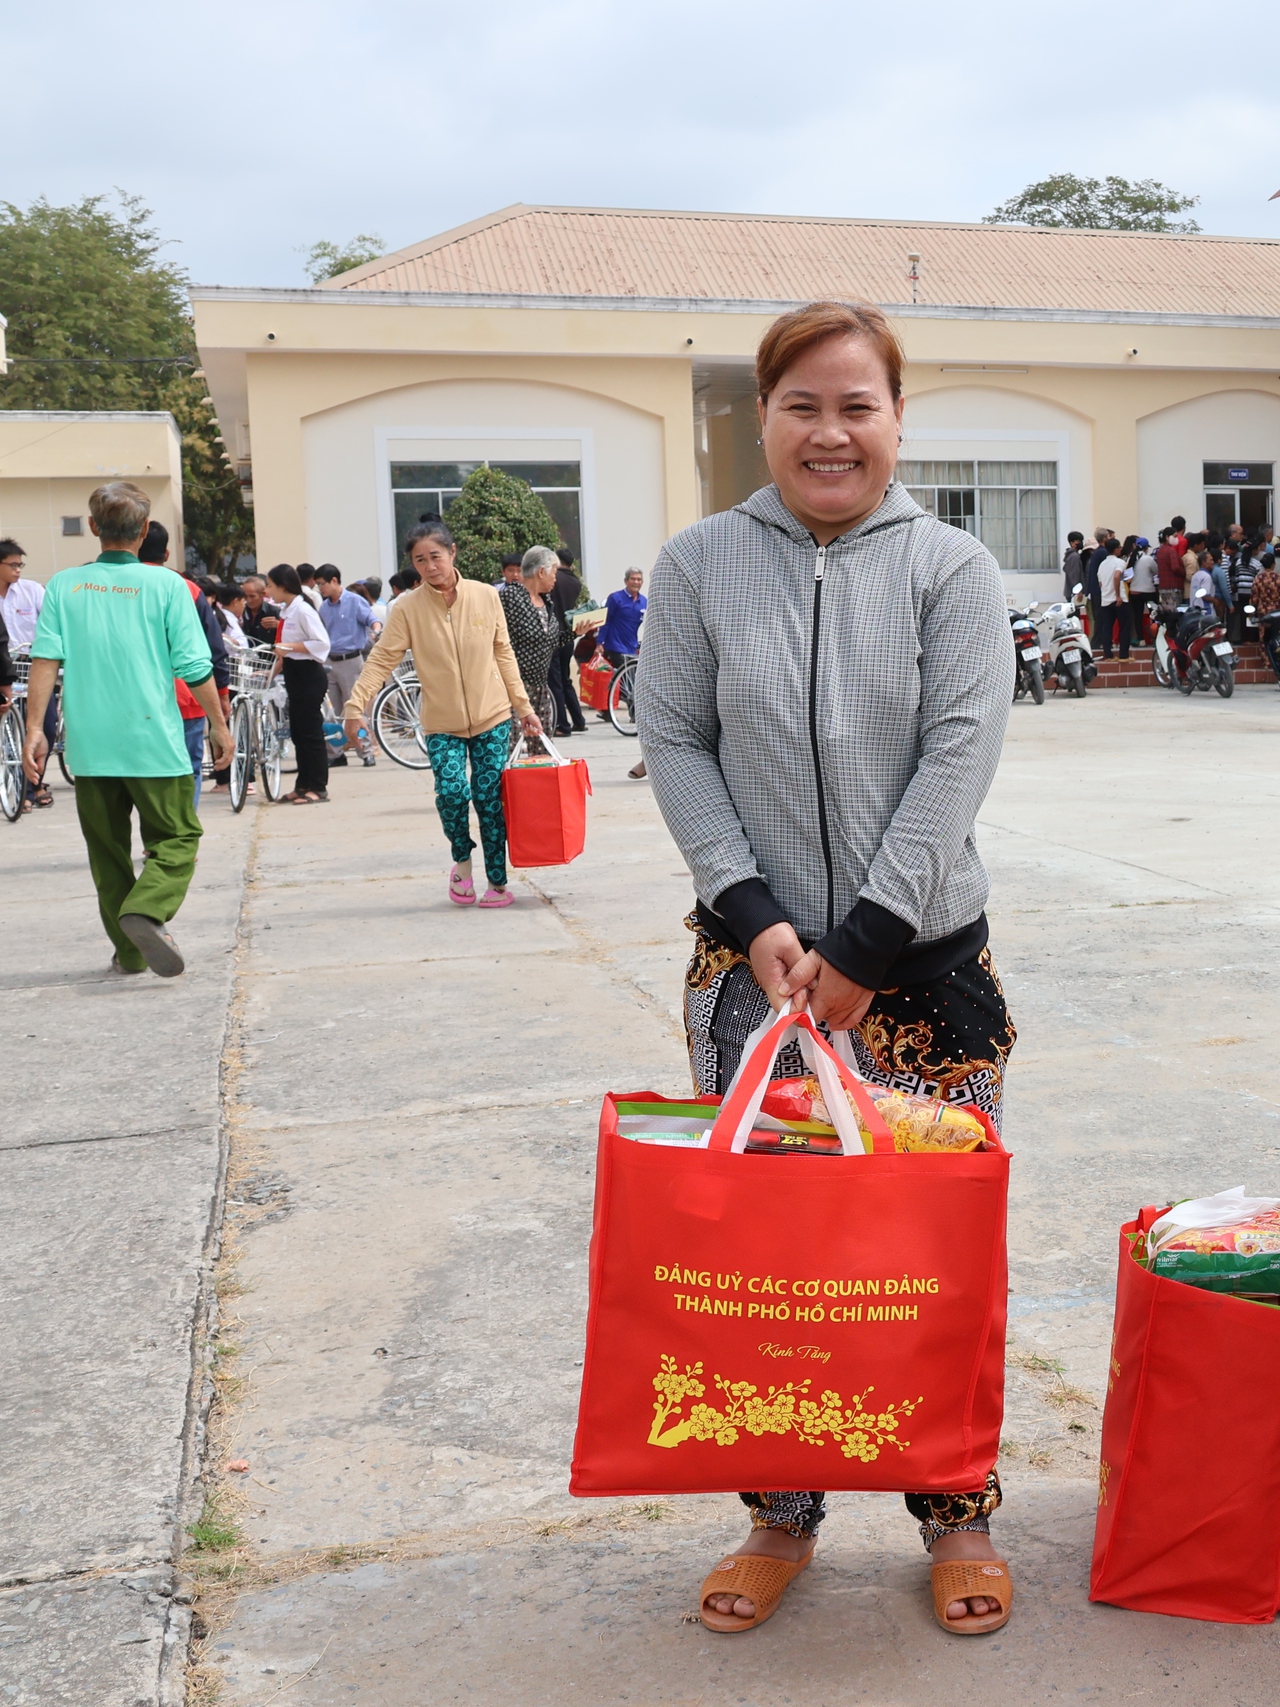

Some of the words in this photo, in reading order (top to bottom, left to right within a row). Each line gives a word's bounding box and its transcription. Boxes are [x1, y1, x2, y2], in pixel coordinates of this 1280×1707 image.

[84, 583, 107, 593] Map
[112, 585, 140, 595] Famy
[654, 1263, 712, 1287] ĐẢNG
[716, 1271, 743, 1291] UỶ
[747, 1275, 787, 1295] CÁC
[791, 1279, 821, 1297] CƠ
[823, 1280, 880, 1298] QUAN
[884, 1274, 939, 1295] ĐẢNG
[674, 1293, 742, 1317] THÀNH
[747, 1300, 791, 1320] PHỐ
[795, 1302, 826, 1323] HỒ
[829, 1303, 863, 1322] CHÍ
[867, 1305, 919, 1321] MINH
[796, 1345, 831, 1364] Tặng
